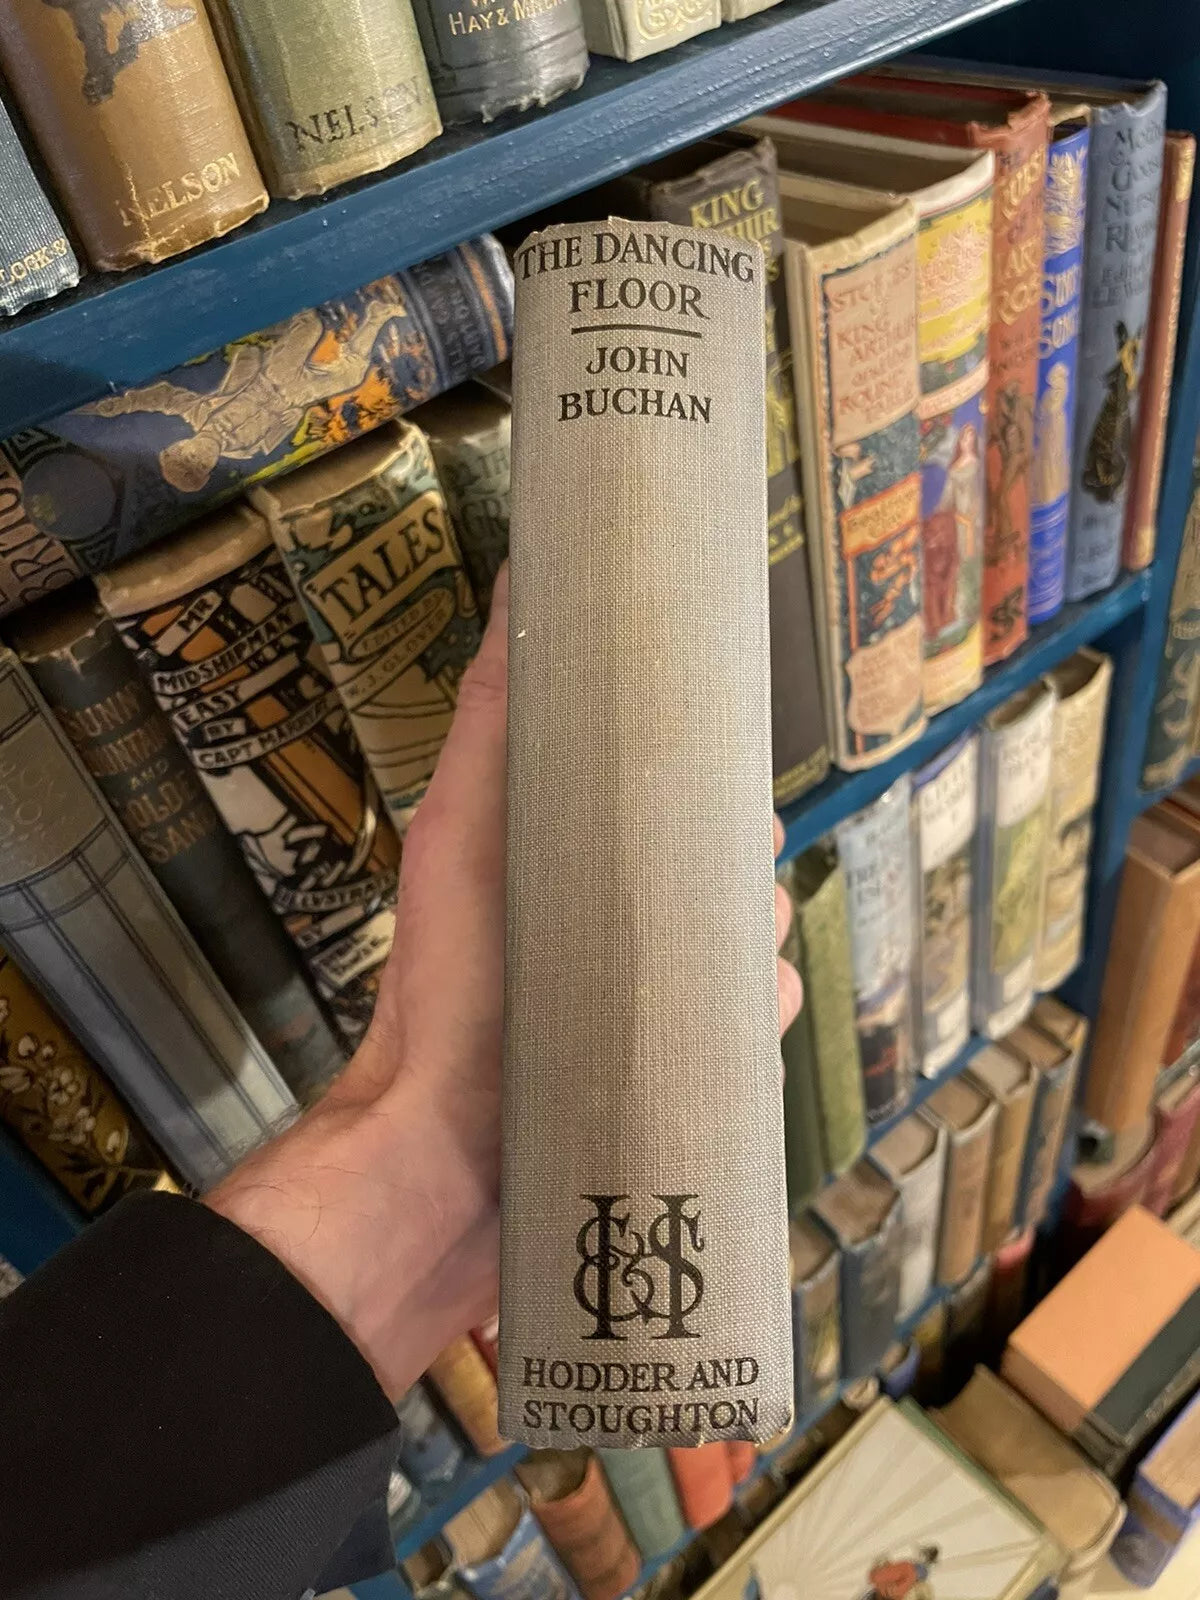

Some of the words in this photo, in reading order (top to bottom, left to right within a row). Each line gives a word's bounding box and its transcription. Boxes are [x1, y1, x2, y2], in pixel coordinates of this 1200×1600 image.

[449, 11, 493, 35] HAY
[496, 8, 509, 26] &
[116, 152, 240, 227] NELSON
[690, 177, 763, 229] KING
[519, 236, 582, 280] THE
[592, 232, 754, 283] DANCING
[568, 277, 711, 320] FLOOR
[585, 346, 689, 378] JOHN
[558, 387, 712, 423] BUCHAN
[320, 506, 444, 625] TALES
[179, 600, 213, 633] MR
[177, 684, 241, 728] EASY
[522, 1356, 679, 1392] HODDER
[687, 1356, 759, 1389] AND
[523, 1398, 759, 1433] STOUGHTON
